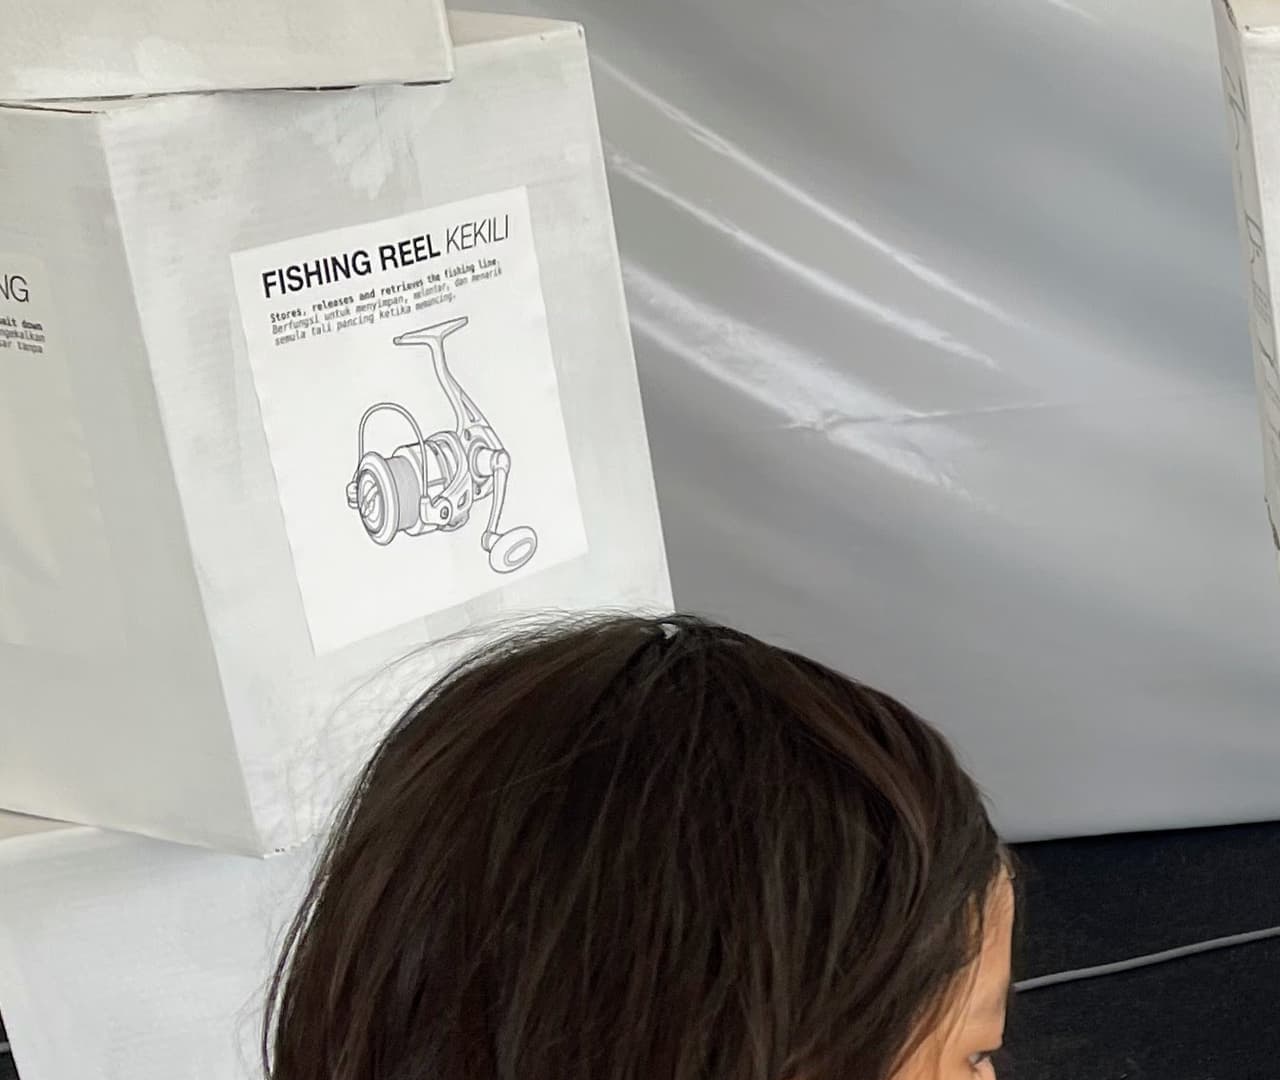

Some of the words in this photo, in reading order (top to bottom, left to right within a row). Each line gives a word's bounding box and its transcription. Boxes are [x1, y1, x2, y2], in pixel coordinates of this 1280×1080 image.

[262, 250, 372, 298] FISHING
[378, 234, 441, 271] REEL
[446, 214, 508, 254] KEKILI
